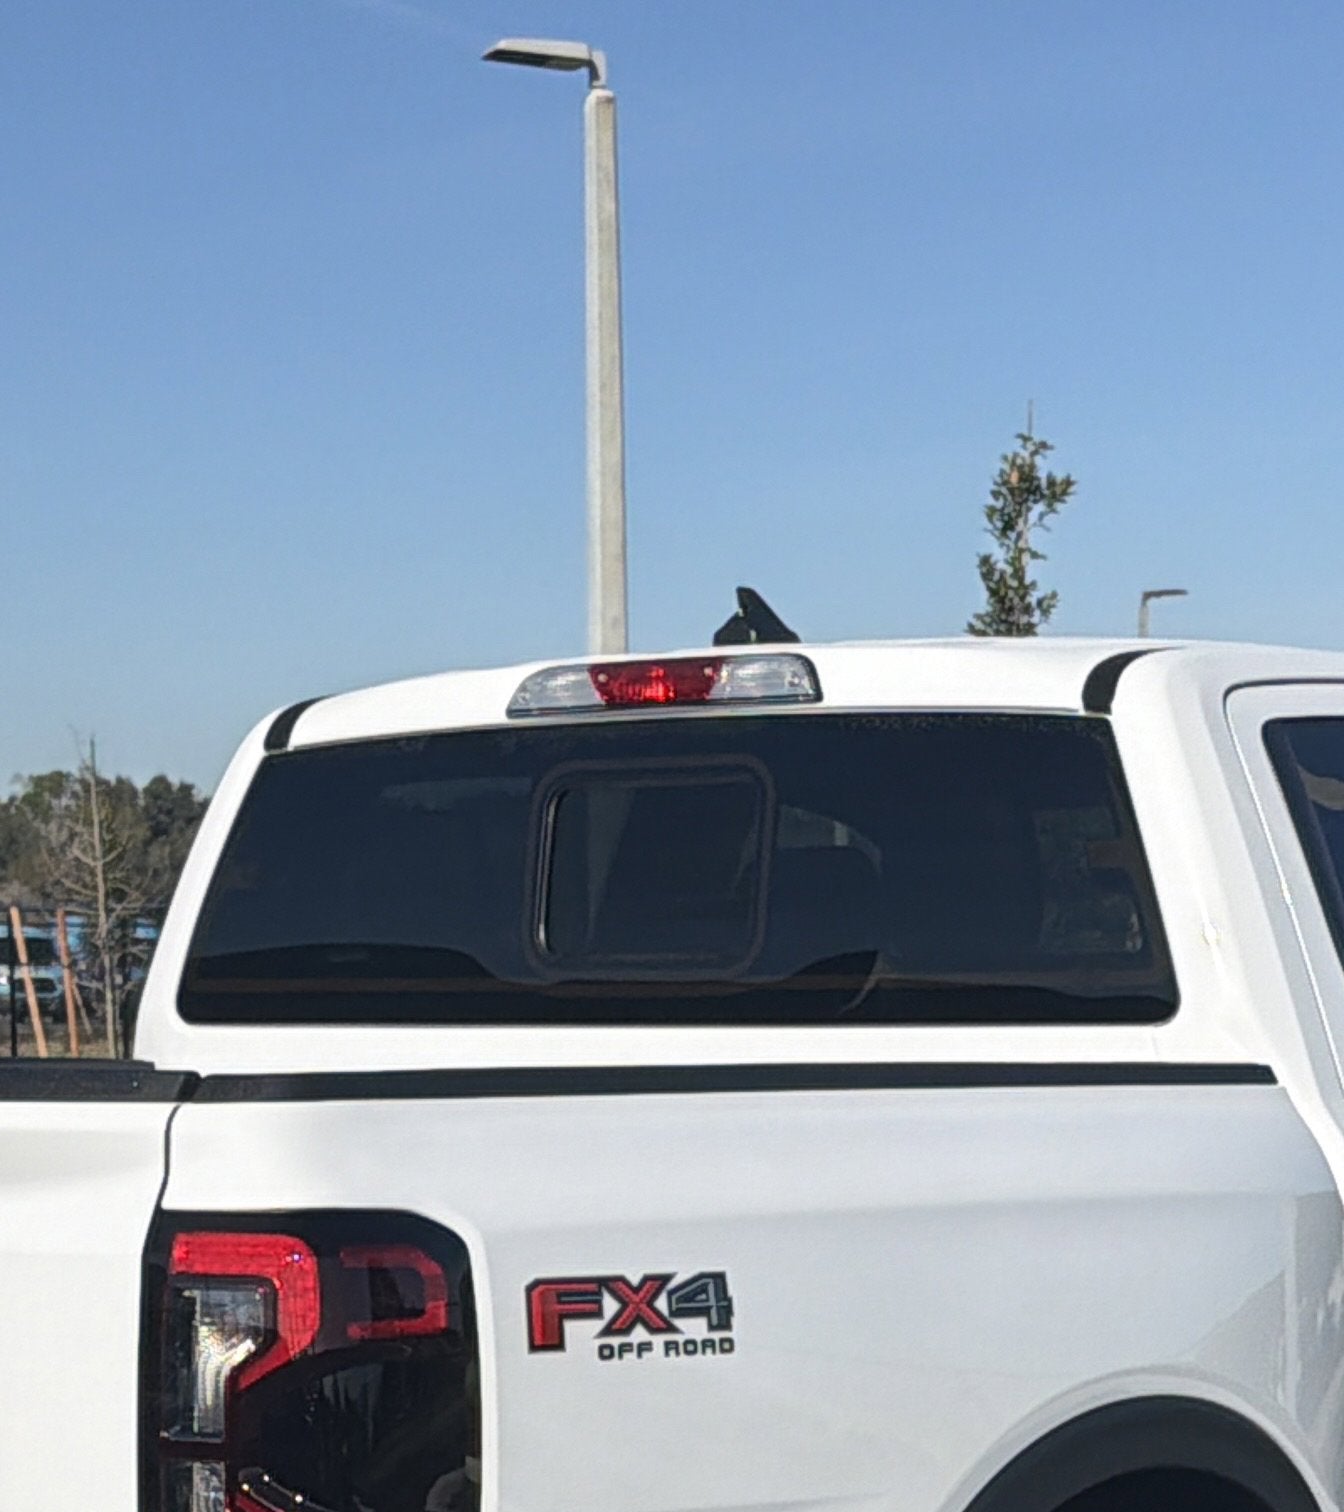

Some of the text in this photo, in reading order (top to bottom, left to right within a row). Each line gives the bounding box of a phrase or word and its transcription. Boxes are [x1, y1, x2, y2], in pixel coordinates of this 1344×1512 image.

[525, 1271, 734, 1354] FX4
[598, 1337, 735, 1361] OFF ROAD
